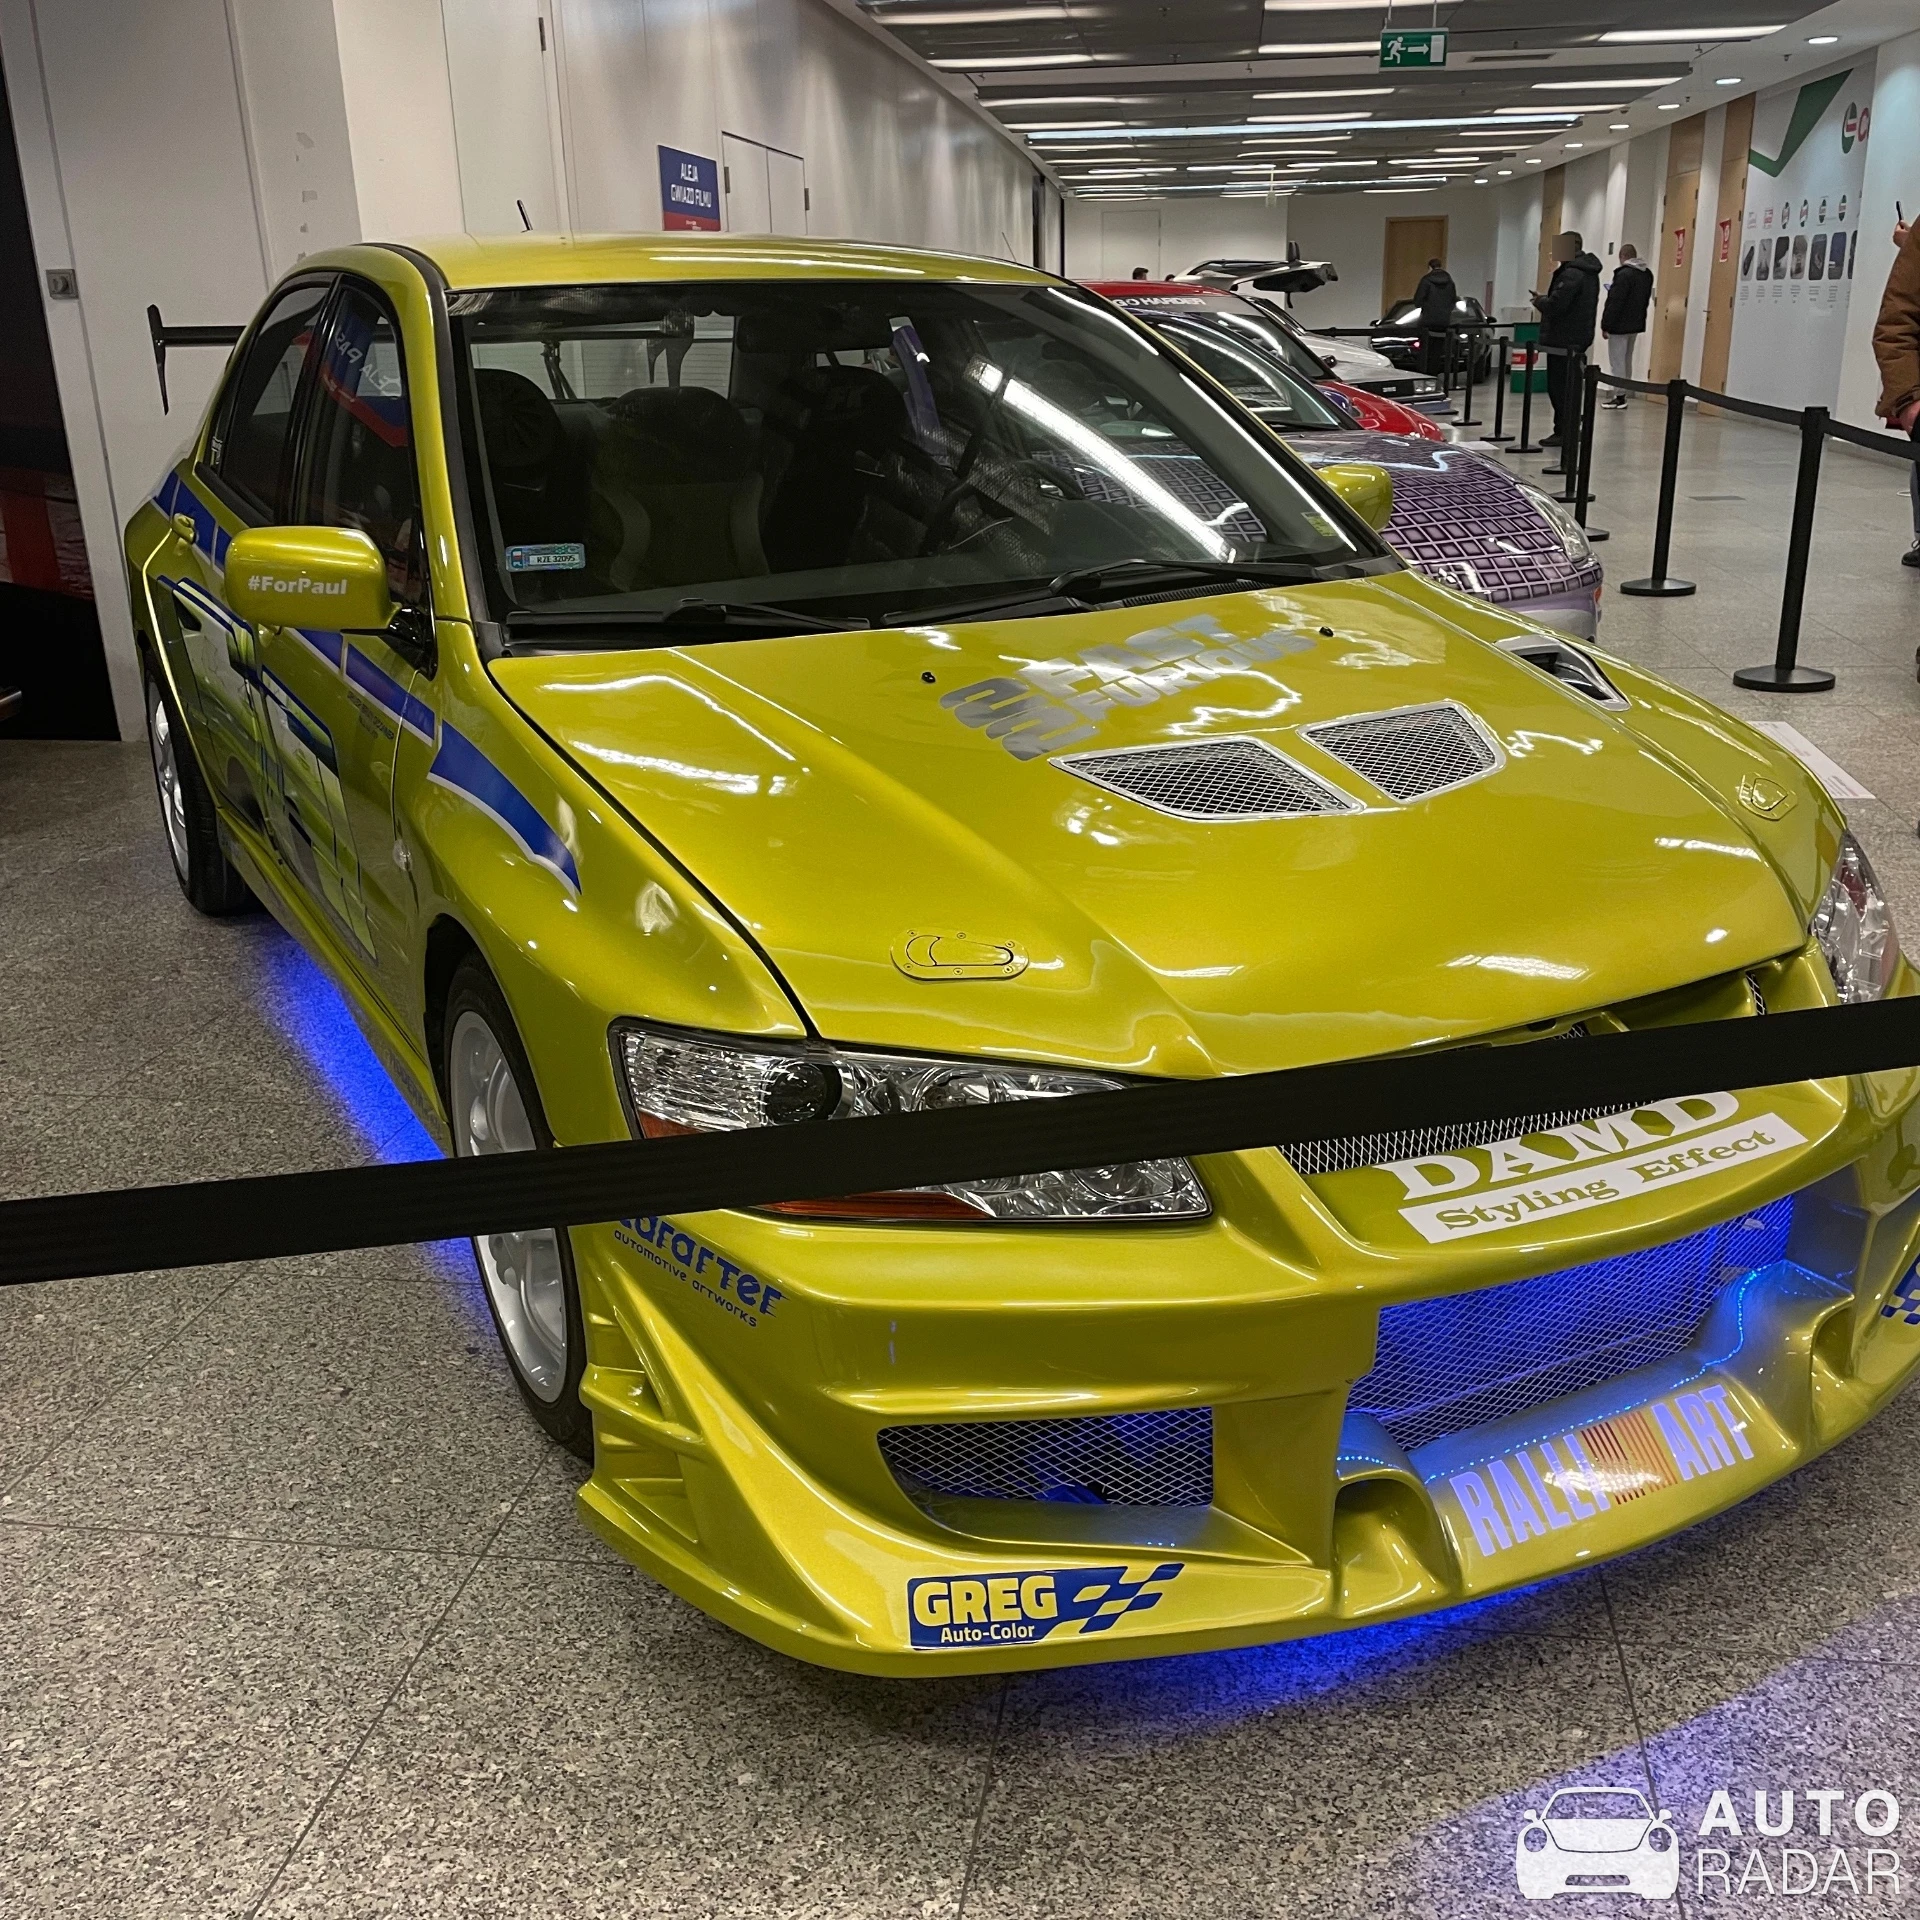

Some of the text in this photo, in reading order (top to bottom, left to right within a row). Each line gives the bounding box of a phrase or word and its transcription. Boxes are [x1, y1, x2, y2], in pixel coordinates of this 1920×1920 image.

[681, 163, 699, 182] ALEJA
[1112, 297, 1206, 307] GO HARDER
[248, 575, 348, 595] #ForPaul
[1016, 613, 1240, 697] FAST
[1065, 630, 1317, 721] FURIOUS
[1381, 1091, 1740, 1201] DAMD
[1435, 1128, 1775, 1231] Styling Effect
[614, 1229, 757, 1328] automotive artworks
[913, 1576, 1058, 1627] GREG
[940, 1623, 1035, 1643] Auto-Color
